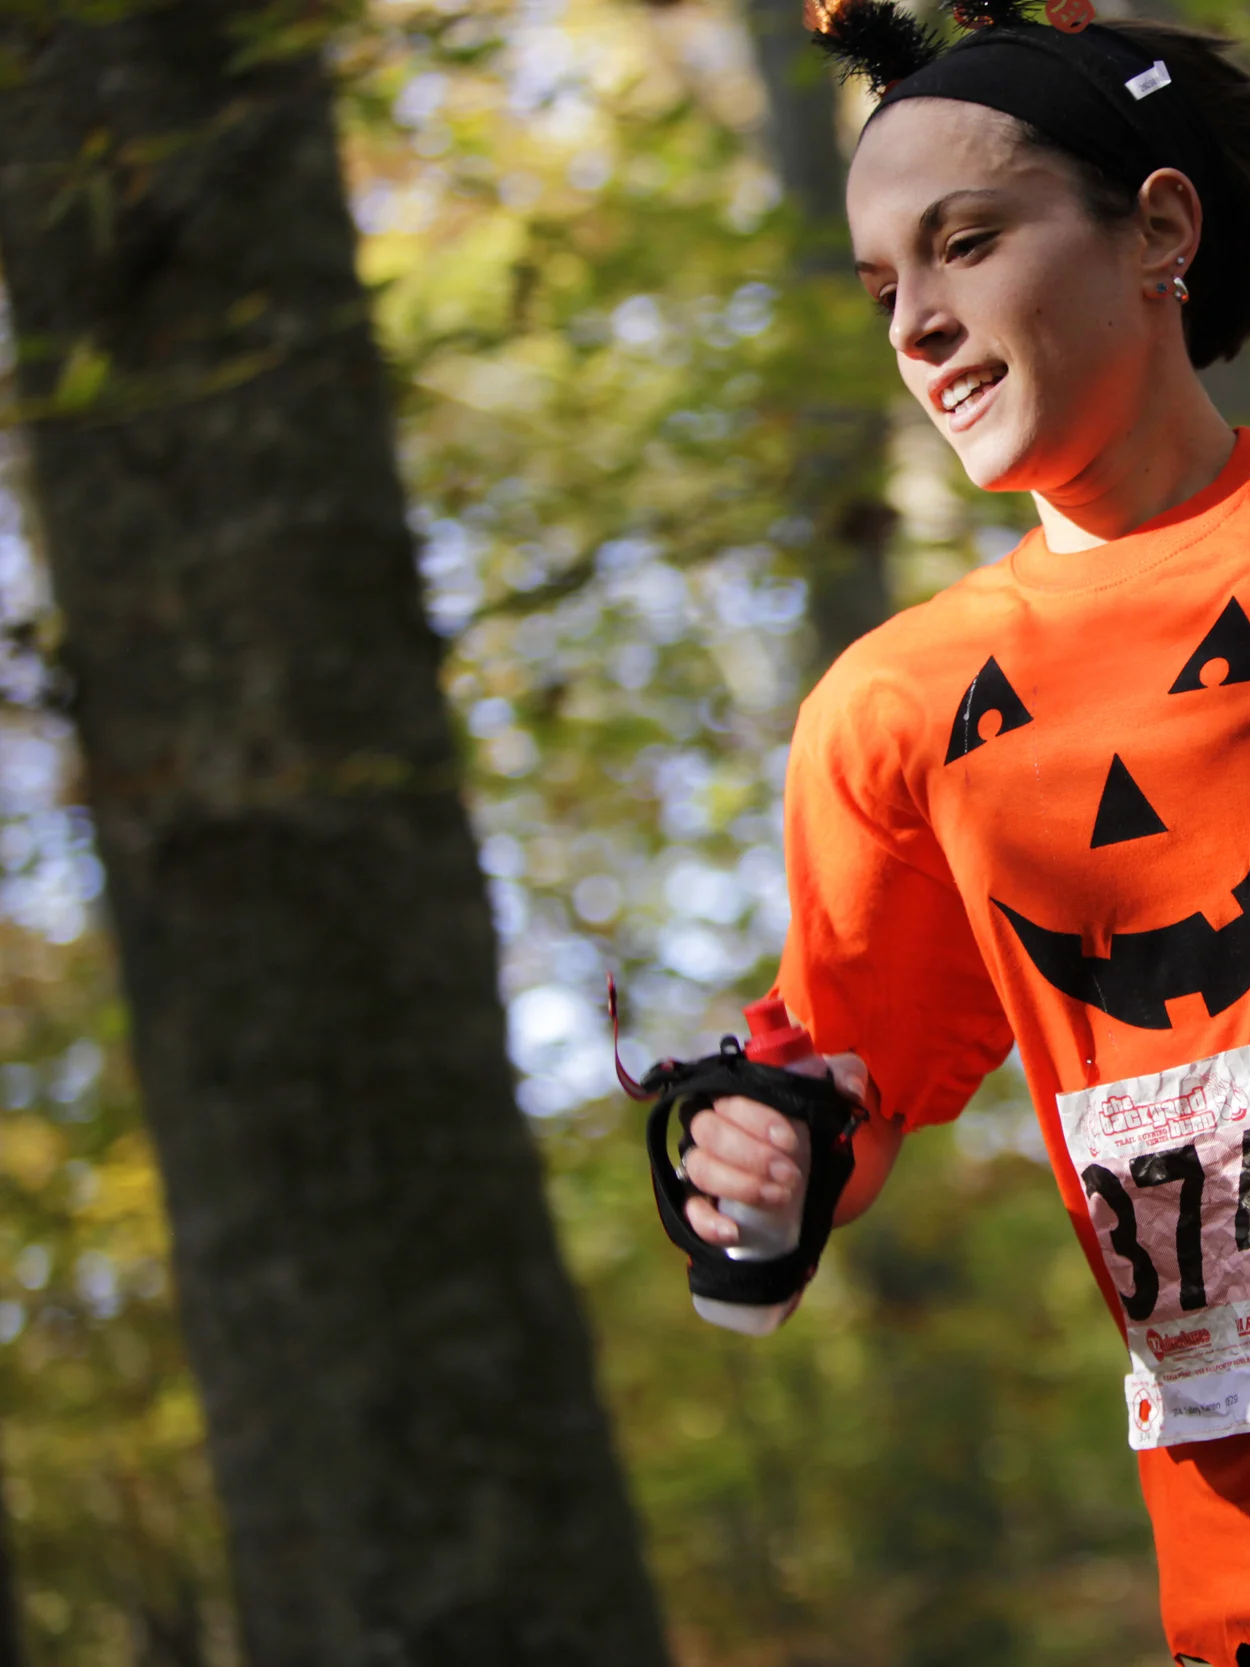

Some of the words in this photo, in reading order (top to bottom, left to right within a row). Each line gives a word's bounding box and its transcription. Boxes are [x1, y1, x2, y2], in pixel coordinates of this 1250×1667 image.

[1099, 1087, 1207, 1136] backyard
[1101, 1095, 1135, 1115] the
[1168, 1111, 1217, 1140] burn
[1114, 1136, 1137, 1147] TRAIL
